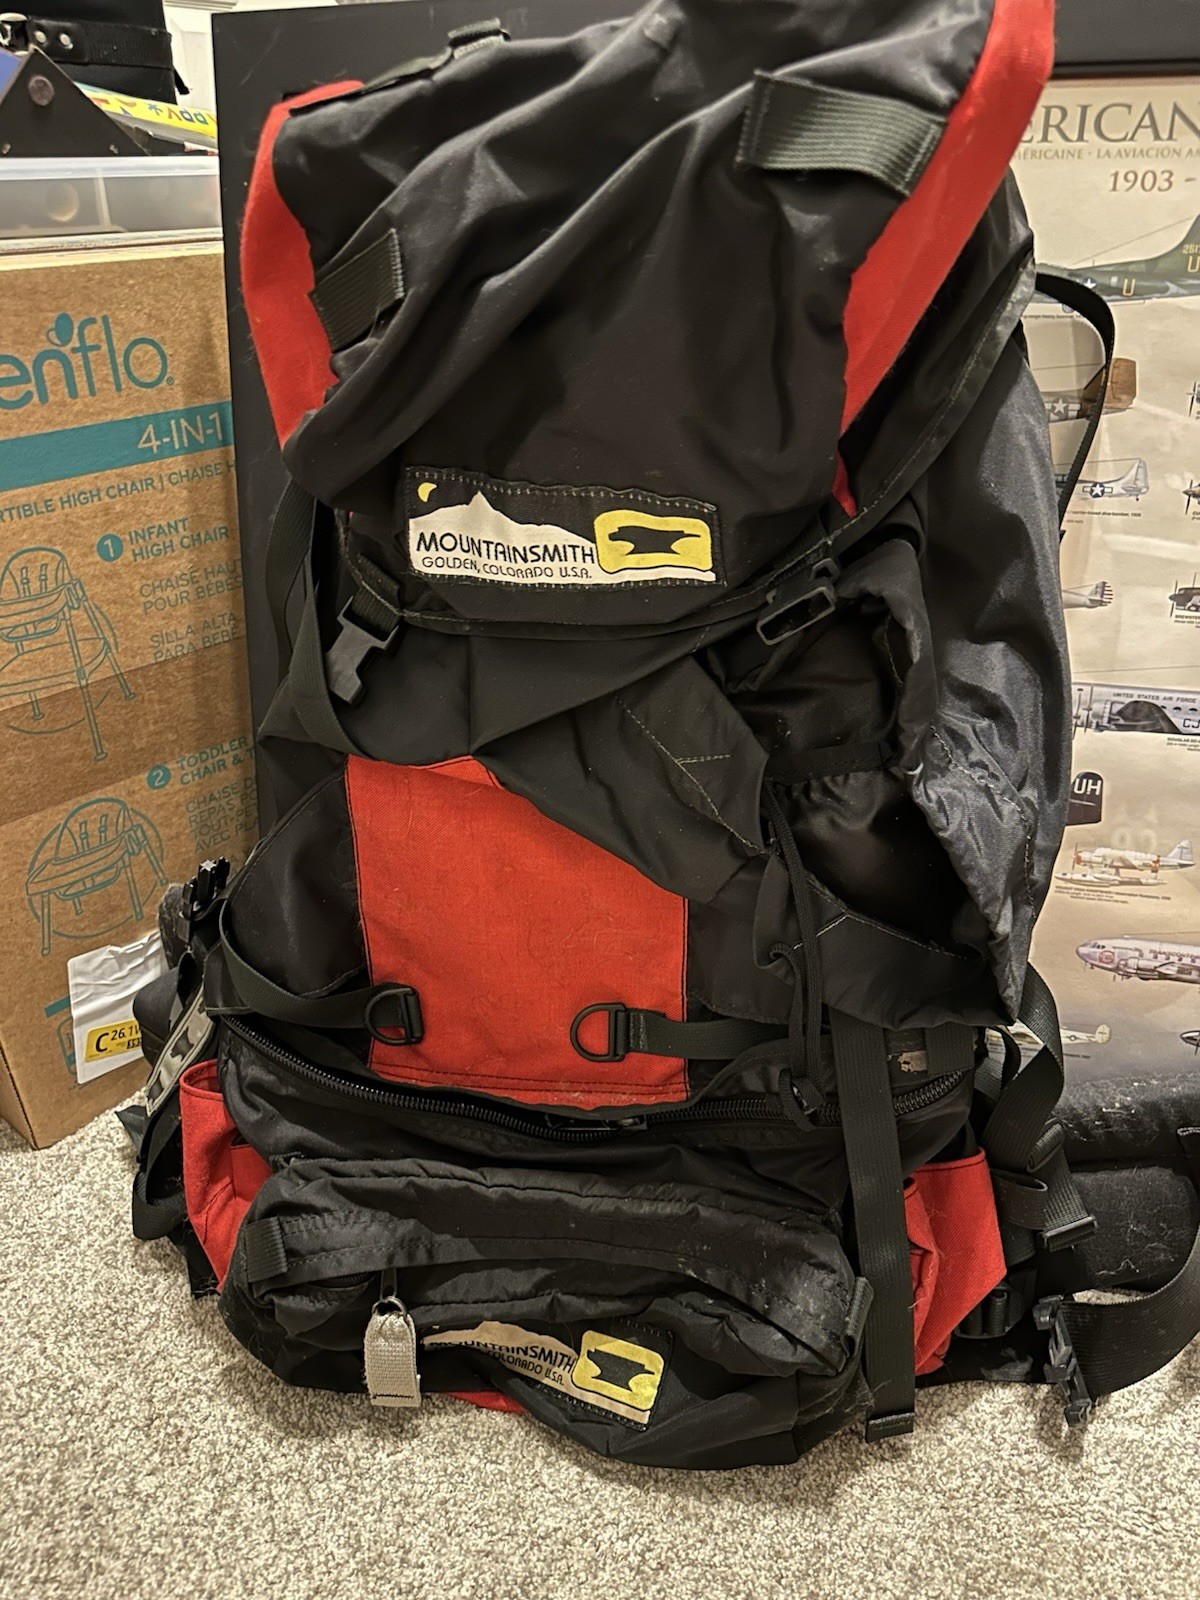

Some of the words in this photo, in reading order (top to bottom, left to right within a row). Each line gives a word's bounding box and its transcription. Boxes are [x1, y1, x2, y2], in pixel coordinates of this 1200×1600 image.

[1108, 170, 1174, 192] 1903
[1122, 278, 1136, 296] U
[137, 411, 223, 454] 4-IN-1
[59, 488, 102, 511] HIGH
[106, 477, 156, 500] CHAIR
[168, 462, 223, 486] CHAISE
[129, 518, 189, 545] INFANT
[132, 539, 175, 562] HIGH
[180, 526, 229, 549] CHAIR
[103, 538, 115, 558] 1
[416, 532, 596, 564] MOUNTAINSMITH
[422, 556, 481, 574] GOLDEN,
[483, 563, 554, 580] COLORADO
[559, 566, 593, 580] U.S.A.
[139, 569, 201, 598] CHAISE
[143, 590, 191, 616] POUR
[150, 624, 197, 649] SILLA
[202, 612, 237, 632] ALTA
[153, 641, 197, 663] PARA
[176, 736, 247, 770] TODDLER
[152, 770, 166, 787] 2
[180, 759, 228, 785] CHAIR
[186, 782, 240, 813] CHAISE
[1073, 778, 1102, 795] UH
[189, 798, 236, 828] REPAS
[195, 829, 231, 854] AVEC
[95, 1032, 109, 1053] C
